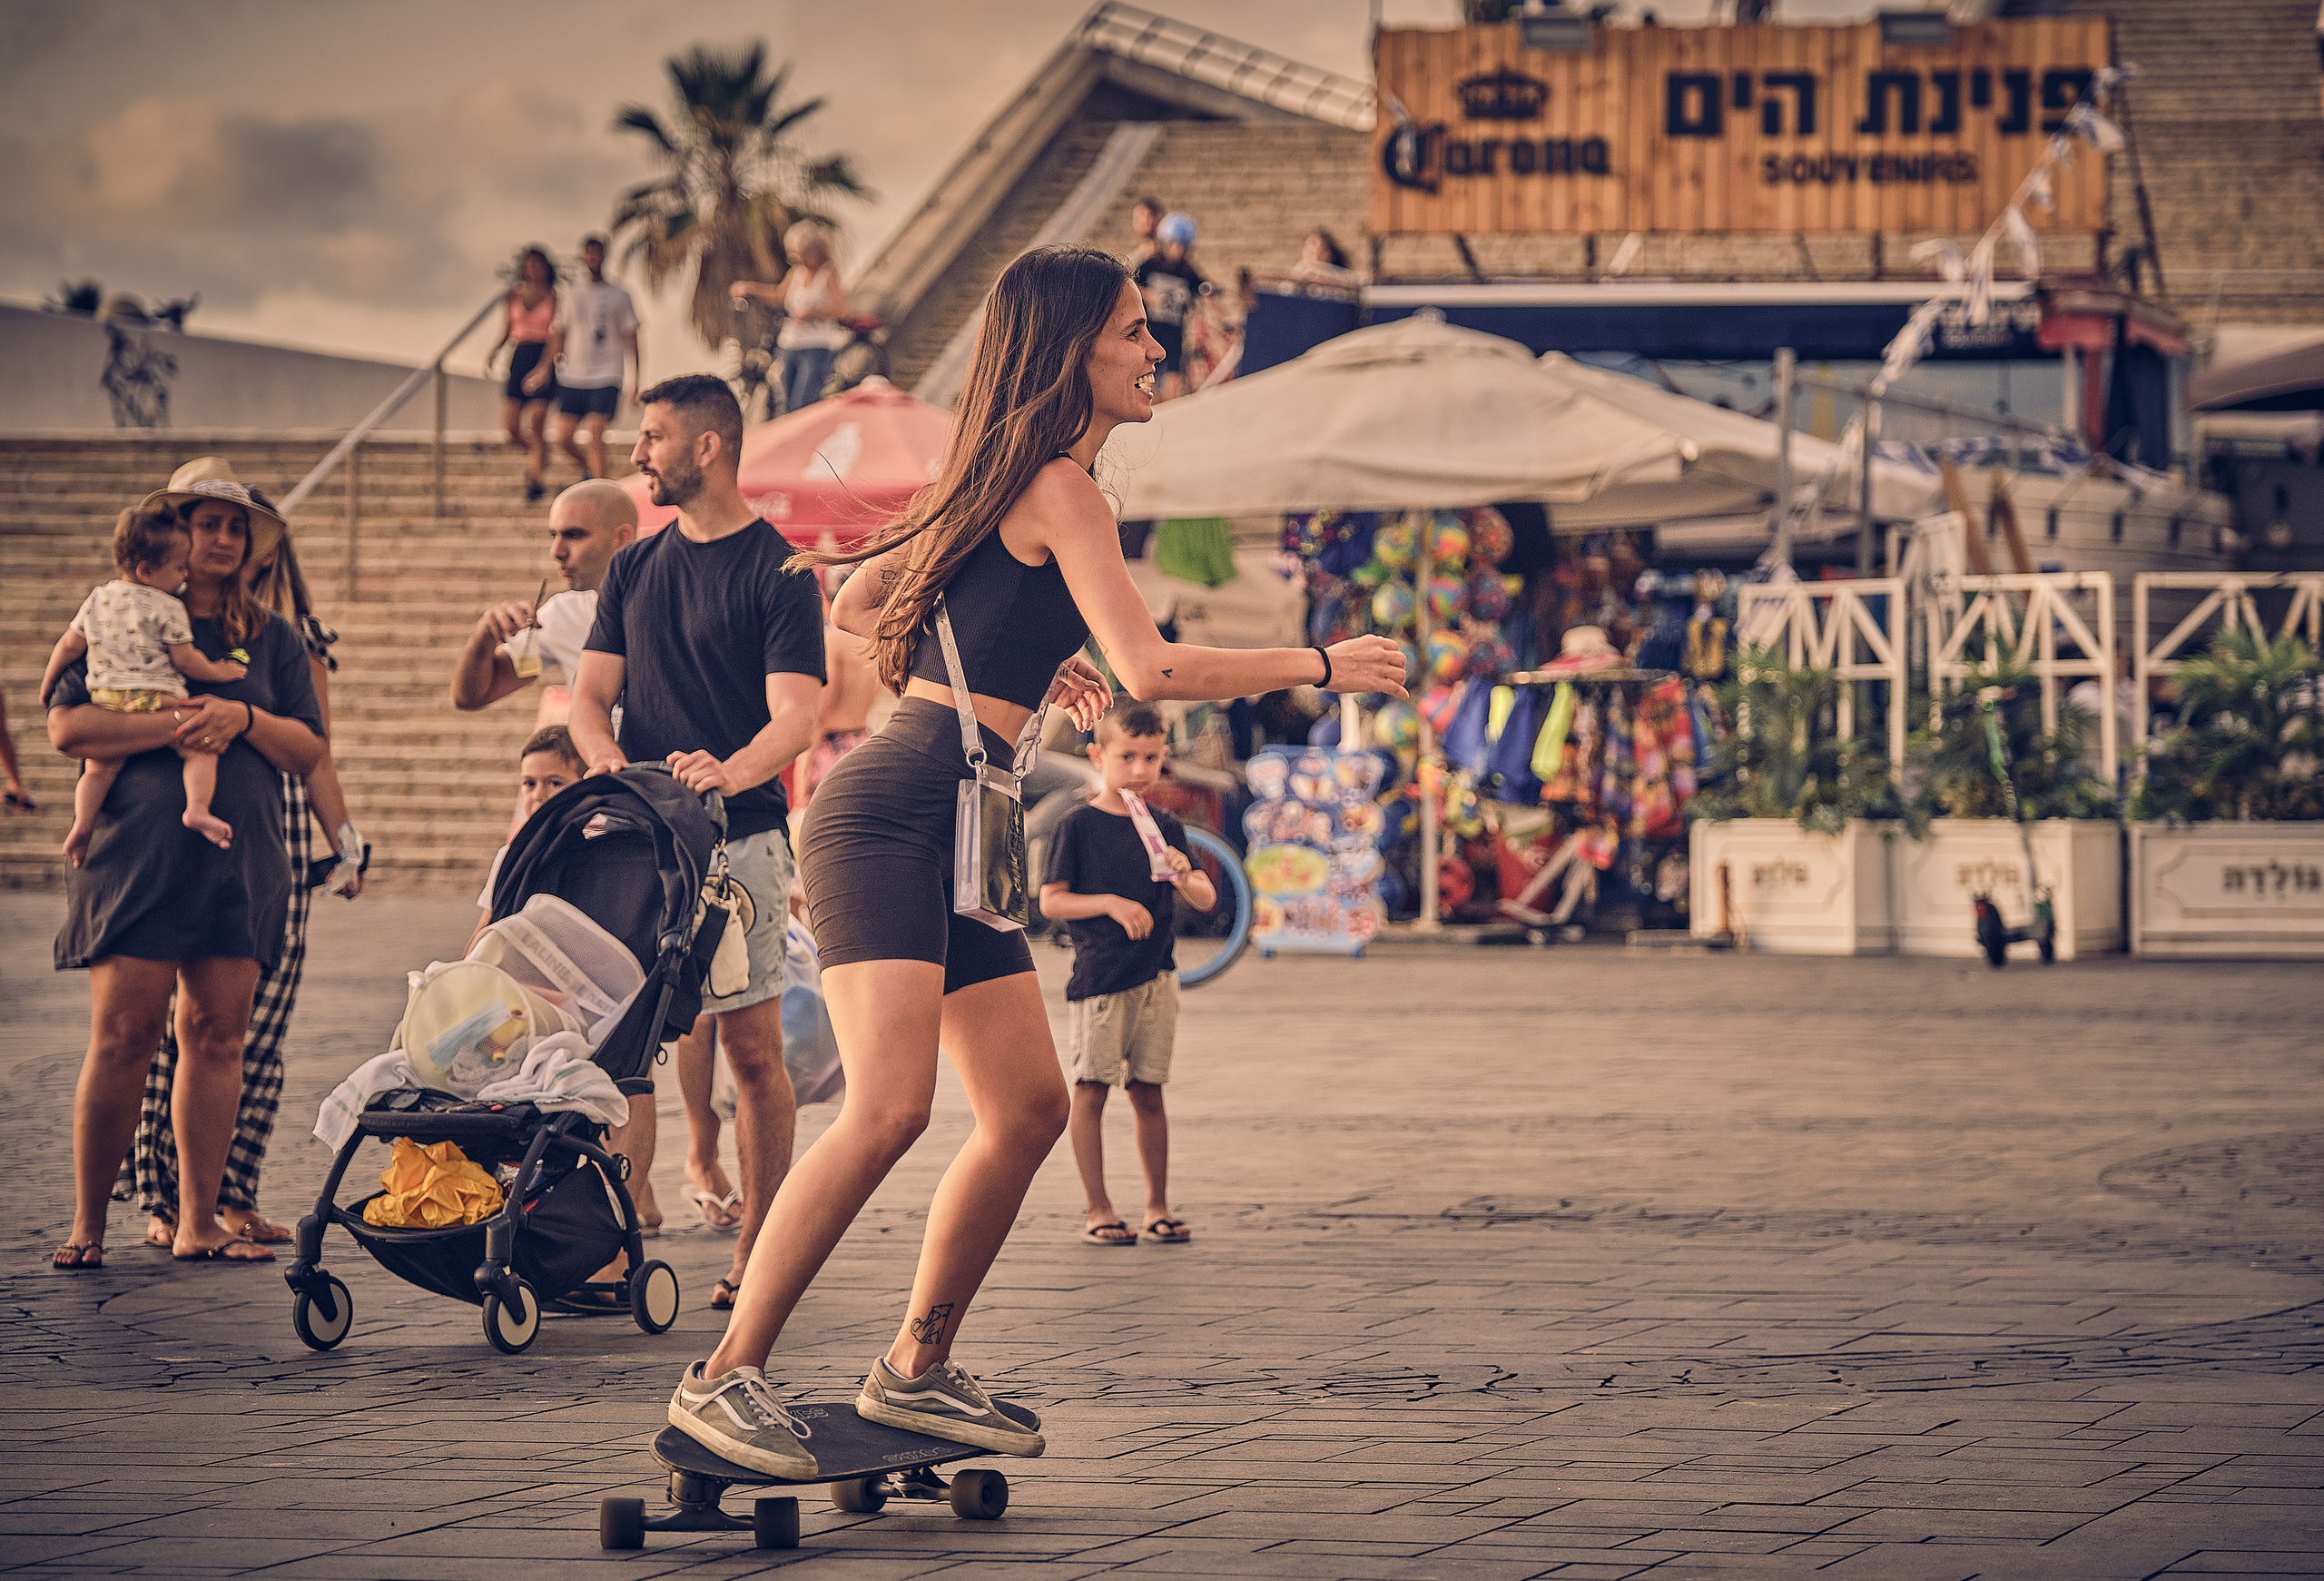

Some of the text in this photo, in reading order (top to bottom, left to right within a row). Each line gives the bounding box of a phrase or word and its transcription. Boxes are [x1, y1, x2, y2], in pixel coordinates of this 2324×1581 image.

[1667, 68, 2099, 135] פנינת הים
[1384, 119, 1610, 195] Corona
